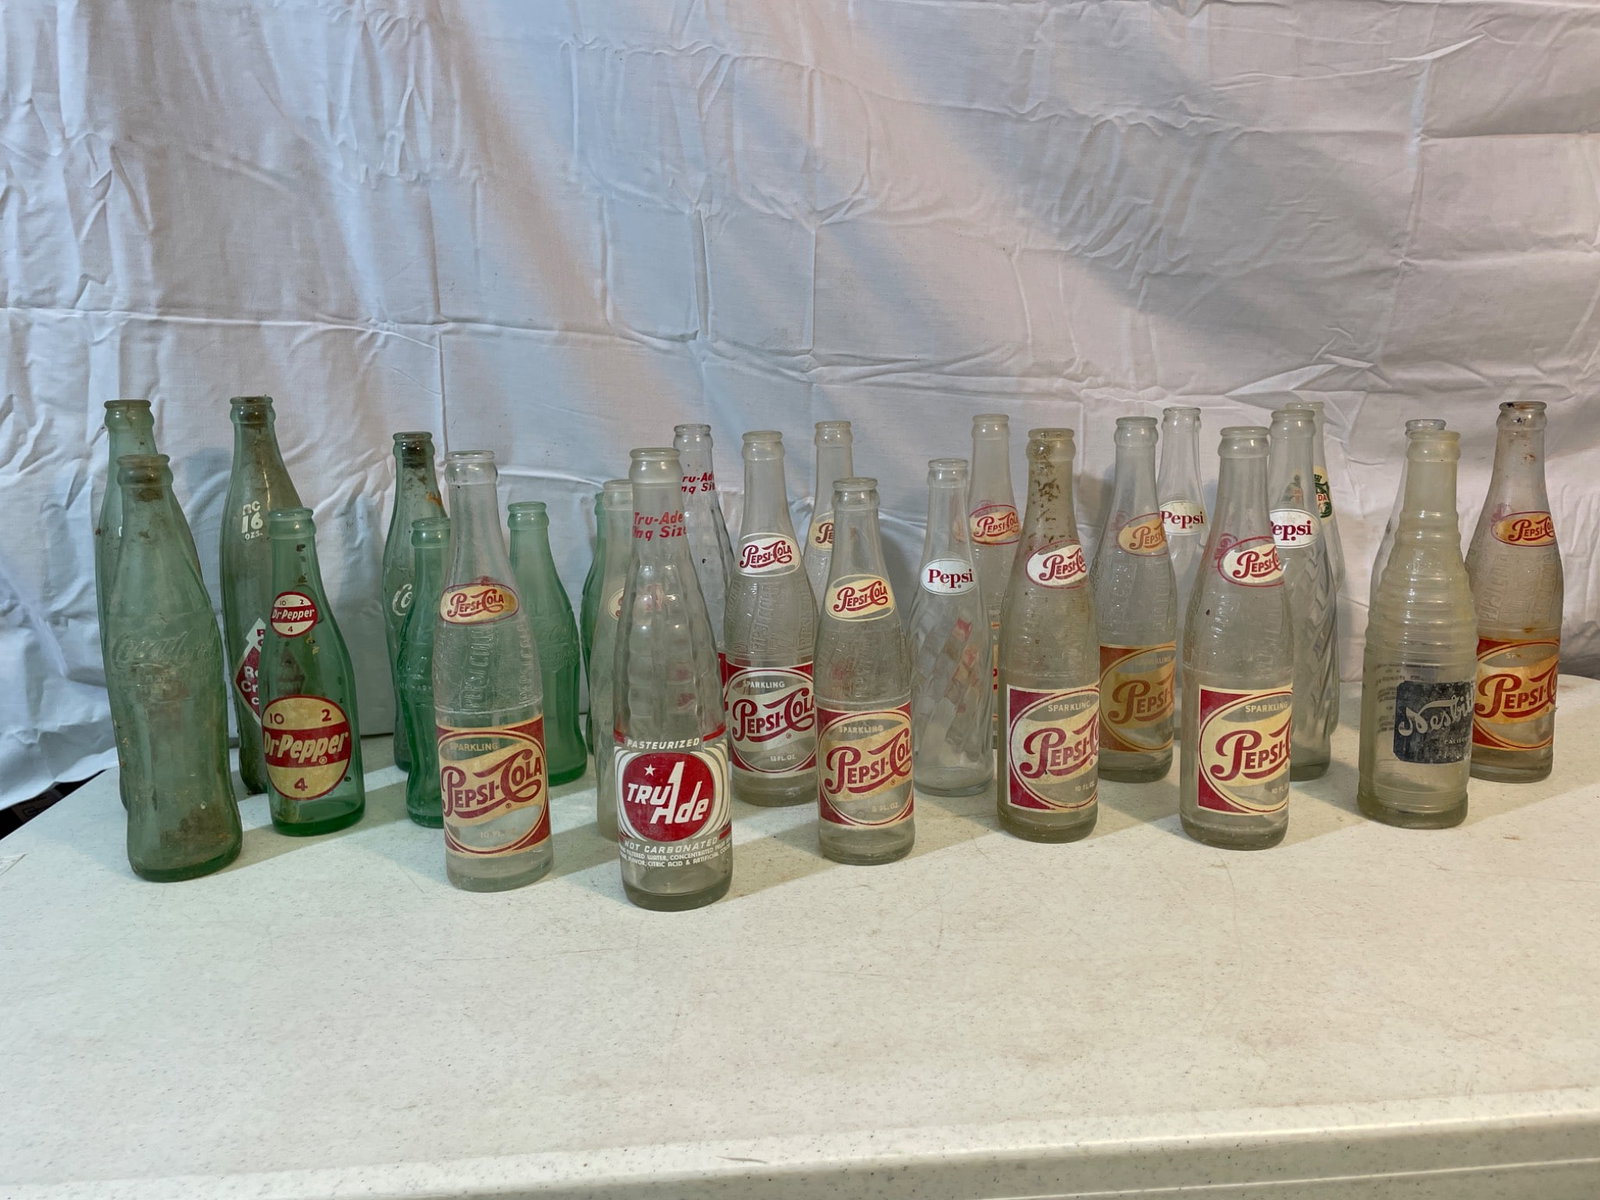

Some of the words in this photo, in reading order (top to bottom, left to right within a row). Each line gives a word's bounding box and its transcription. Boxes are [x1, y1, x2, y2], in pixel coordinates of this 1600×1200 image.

[681, 472, 714, 483] ru-Ad
[241, 512, 263, 533] 16
[634, 510, 684, 525] Tru-Ade
[1160, 510, 1204, 529] Pepsi
[1271, 520, 1313, 541] epsi
[928, 568, 974, 589] Pepsi
[282, 609, 315, 620] Pepper
[269, 713, 284, 724] 10
[321, 709, 331, 722] 2
[264, 731, 279, 756] Dr
[277, 732, 349, 763] Pepper
[626, 737, 700, 750] PASTEURIZED
[294, 778, 308, 791] 4
[627, 782, 672, 806] TRU
[624, 840, 640, 850] NOT
[644, 837, 718, 854] CARBONATED
